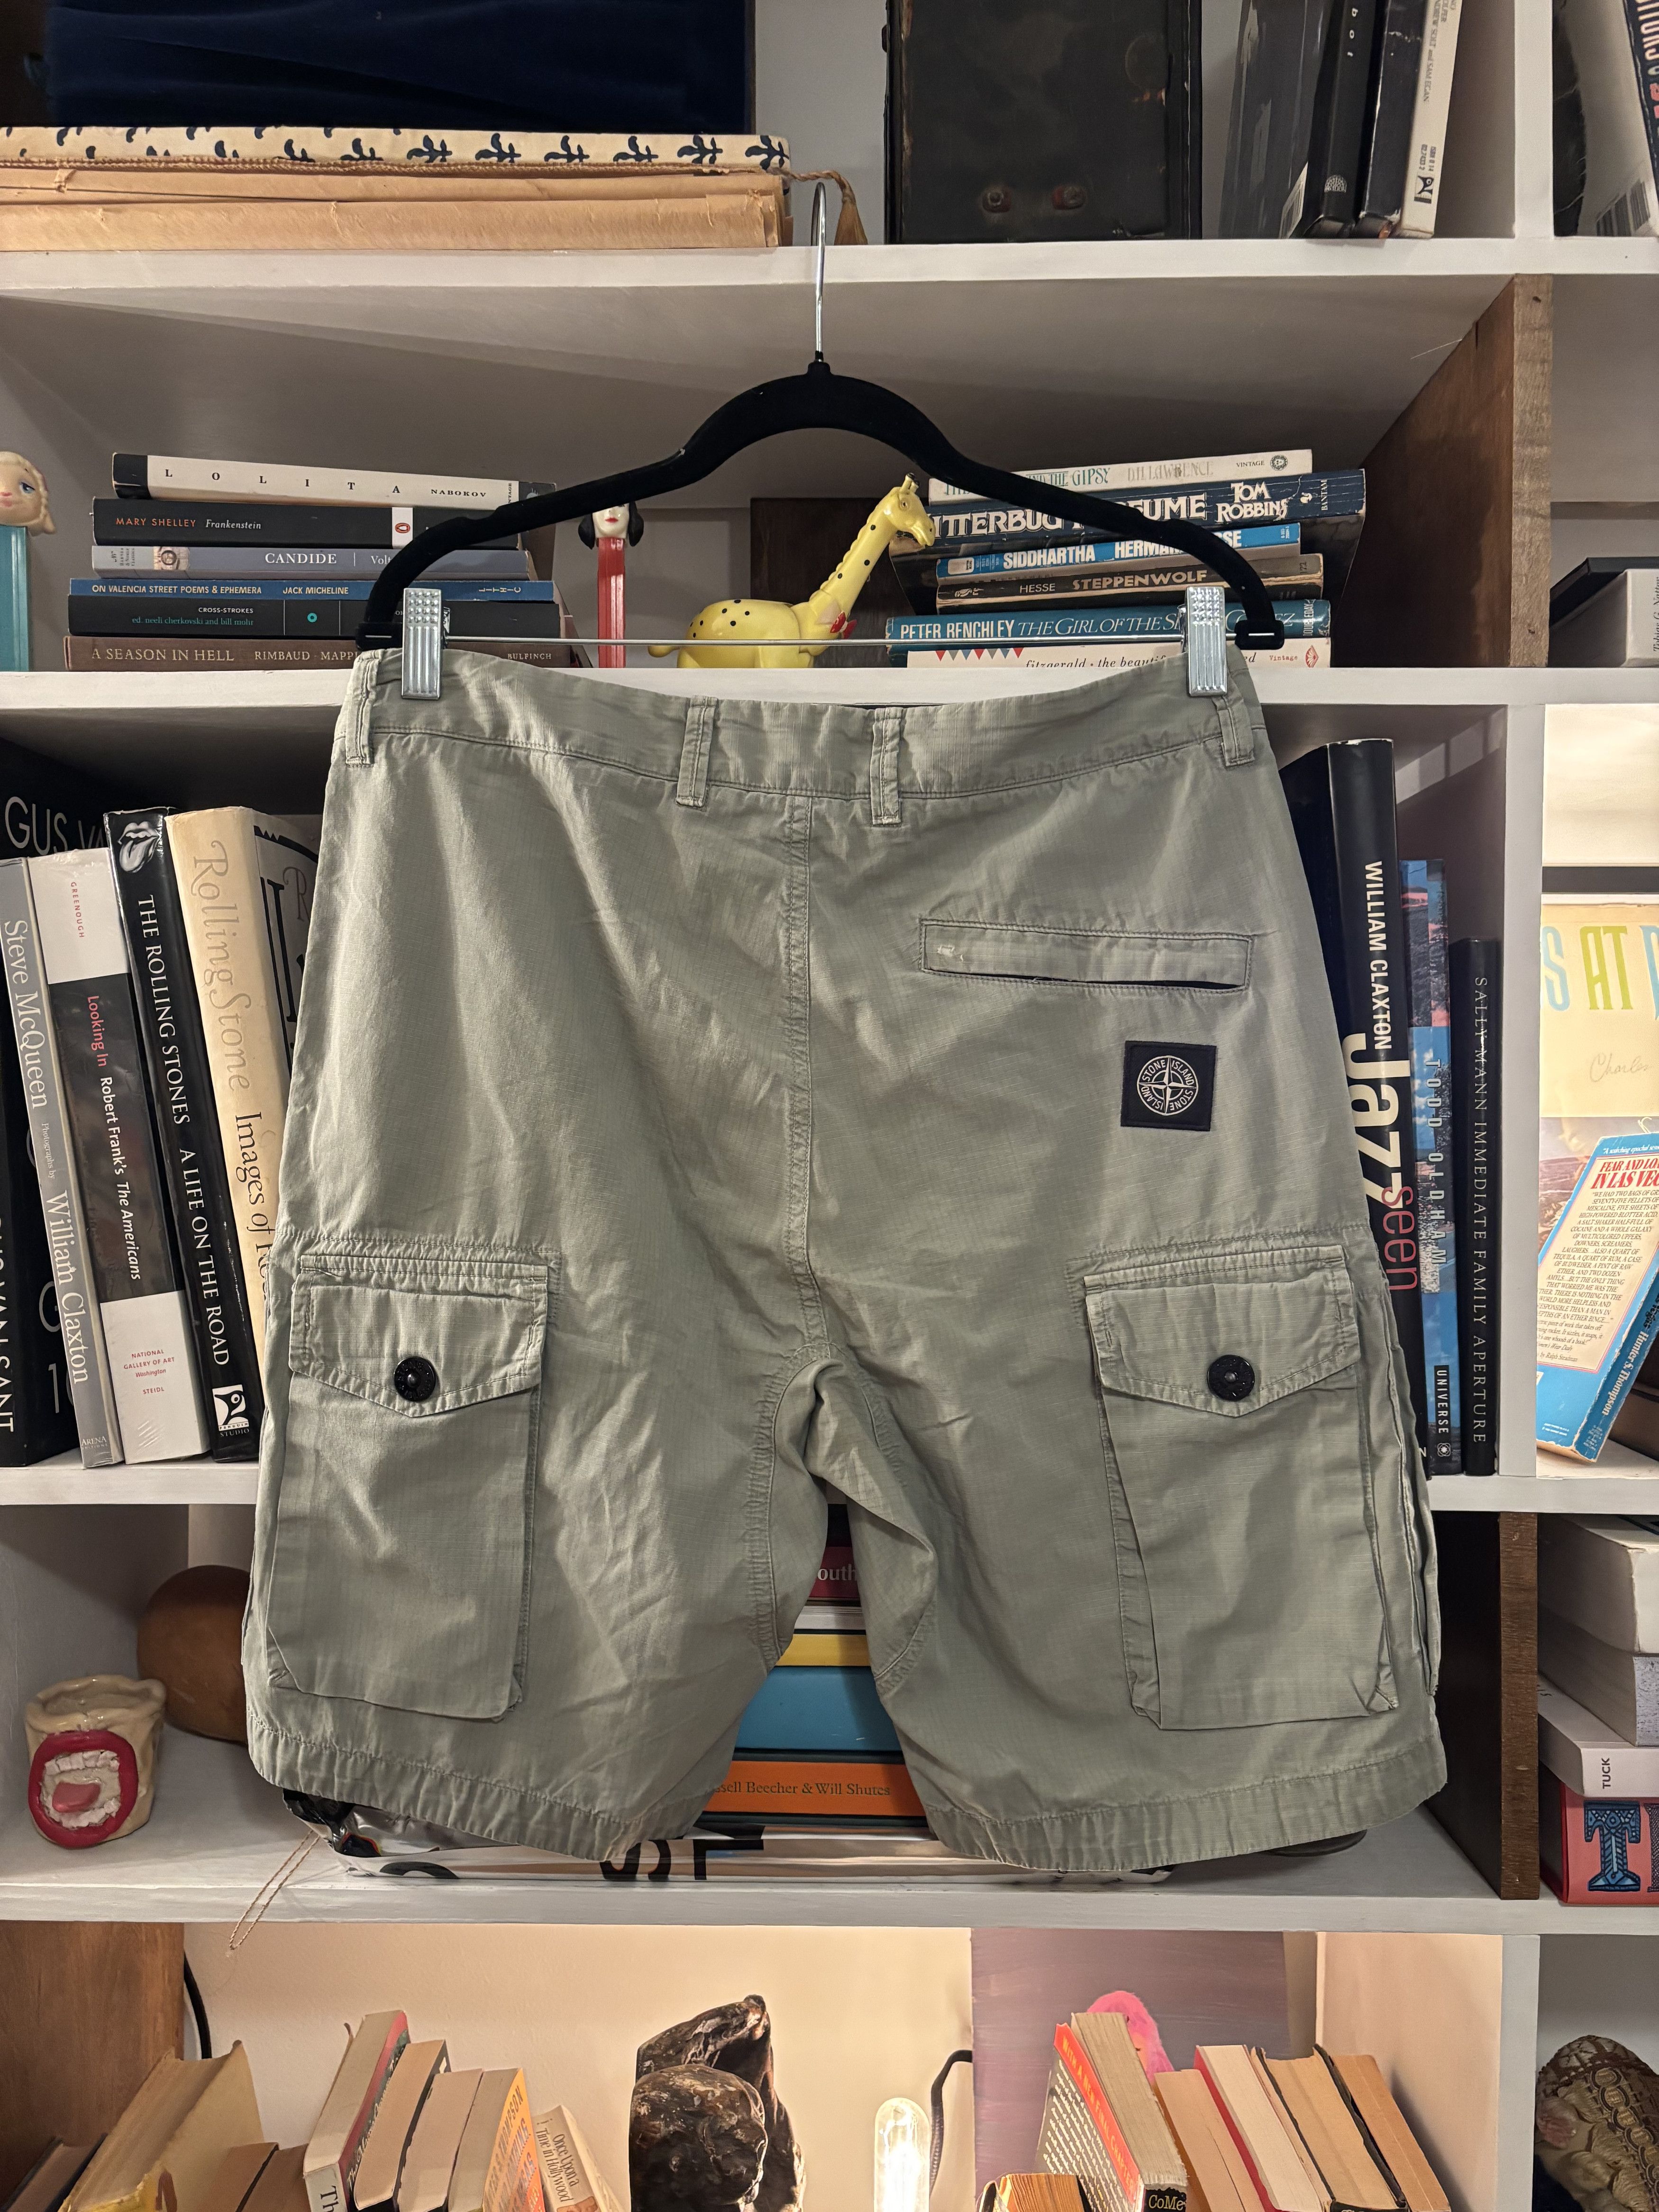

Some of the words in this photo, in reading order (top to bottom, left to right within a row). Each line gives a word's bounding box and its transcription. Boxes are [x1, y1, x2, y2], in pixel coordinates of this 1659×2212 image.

[1072, 468, 1111, 487] GIPSY
[1236, 460, 1265, 468] VINTAGE
[430, 488, 487, 498] NABOKOV
[1231, 481, 1272, 503] TOM
[116, 517, 146, 527] MARY
[151, 518, 196, 528] SHELLEY
[206, 518, 262, 530] Frankenstein
[1217, 499, 1288, 523] ROBBINS
[264, 553, 337, 564] CANDIDE
[1003, 545, 1096, 570] SIDDHARTHA
[92, 585, 106, 593] ON
[109, 585, 146, 594] VALENCIA
[149, 586, 178, 594] STREET
[220, 586, 262, 595] EPHEMERA
[305, 587, 349, 595] MICHELINE
[1020, 583, 1056, 594] HESSE
[1072, 570, 1207, 591] STEPPENWOLF
[164, 617, 203, 626] cherkovski
[234, 618, 254, 626] mohr
[901, 624, 941, 639] PETER
[947, 619, 1015, 639] BENCHLEY
[1019, 621, 1054, 636] THE
[1054, 618, 1095, 635] GIRL
[1099, 618, 1125, 634] OF
[1125, 615, 1162, 632] THE
[1304, 600, 1314, 637] DOUBLEDAY
[92, 649, 101, 659] A
[107, 649, 166, 661] SEASON
[172, 650, 189, 661] IN
[194, 650, 235, 662] HELL
[255, 651, 310, 661] RIMBAUD
[1097, 657, 1119, 668] the
[5, 796, 67, 856] GUS
[71, 882, 85, 938] GREENOUGH
[137, 894, 160, 938] THE
[191, 840, 239, 988] Rolling
[1365, 861, 1387, 951] WILLIAM
[4, 919, 29, 985] Steve
[1579, 925, 1634, 1010] AT
[145, 944, 176, 1039] ROLLING
[1369, 959, 1393, 1050] CLAXTON
[1475, 977, 1488, 1040] SALLY
[87, 995, 105, 1051] Looking
[15, 992, 48, 1109] McQueen
[209, 989, 252, 1092] Stone
[96, 1053, 109, 1067] In
[1141, 1059, 1166, 1082] STONE
[1171, 1060, 1194, 1086] ISLAND
[162, 1045, 190, 1125] STONES
[1425, 1058, 1442, 1128] TODD
[1475, 1049, 1487, 1111] MANN
[100, 1076, 119, 1125] Robert
[1140, 1086, 1164, 1111] ISLAND
[1169, 1089, 1194, 1111] STONE
[41, 1122, 55, 1170] Photographs
[108, 1126, 128, 1175] Frank's
[179, 1148, 197, 1164] A
[235, 1111, 265, 1206] Images
[48, 1171, 56, 1180] by
[1599, 1161, 1624, 1172] FEAR
[1623, 1159, 1644, 1171] AND
[183, 1167, 205, 1211] LIFE
[1474, 1122, 1487, 1239] IMMEDIATE
[1591, 1173, 1611, 1189] IN
[1606, 1171, 1637, 1188] LAS
[117, 1182, 129, 1207] The
[1428, 1152, 1447, 1265] OLDHAM
[46, 1189, 76, 1286] William
[191, 1216, 211, 1249] ON
[246, 1213, 276, 1235] of
[120, 1209, 141, 1280] Americans
[1381, 1186, 1418, 1291] seen
[198, 1255, 219, 1300] THE
[1473, 1250, 1486, 1325] FAMILY
[1577, 1292, 1602, 1300] NOTHING
[61, 1292, 89, 1384] Claxton
[206, 1304, 230, 1366] ROAD
[1627, 1331, 1649, 1363] Hunter
[123, 1360, 151, 1370] GALLERY
[131, 1349, 164, 1359] NATIONAL
[1624, 1360, 1633, 1372] S.
[135, 1368, 166, 1378] Washington
[143, 1387, 165, 1395] STEIDL
[1436, 1370, 1449, 1434] UNIVERSE
[1473, 1335, 1486, 1443] APERTURE
[1601, 1369, 1631, 1416] Thompson
[81, 1436, 107, 1446] ARENA
[219, 1428, 250, 1438] STUDIO
[1602, 1757, 1612, 1790] TUCK
[747, 1781, 798, 1794] Beecher
[802, 1783, 813, 1794] &
[815, 1782, 843, 1795] Will
[847, 1783, 891, 1796] Shutes
[498, 2085, 524, 2160] THOMPSON
[1062, 2037, 1078, 2069] WITH
[1076, 2065, 1084, 2076] A
[1083, 2075, 1095, 2105] NEW
[1094, 2102, 1110, 2140] FINAL
[1110, 2135, 1136, 2189] CHAPTER
[536, 2127, 551, 2150] Time
[553, 2133, 569, 2157] Once
[542, 2148, 556, 2158] in
[561, 2154, 578, 2179] Upon
[545, 2157, 574, 2203] Hollywood
[568, 2178, 580, 2187] a
